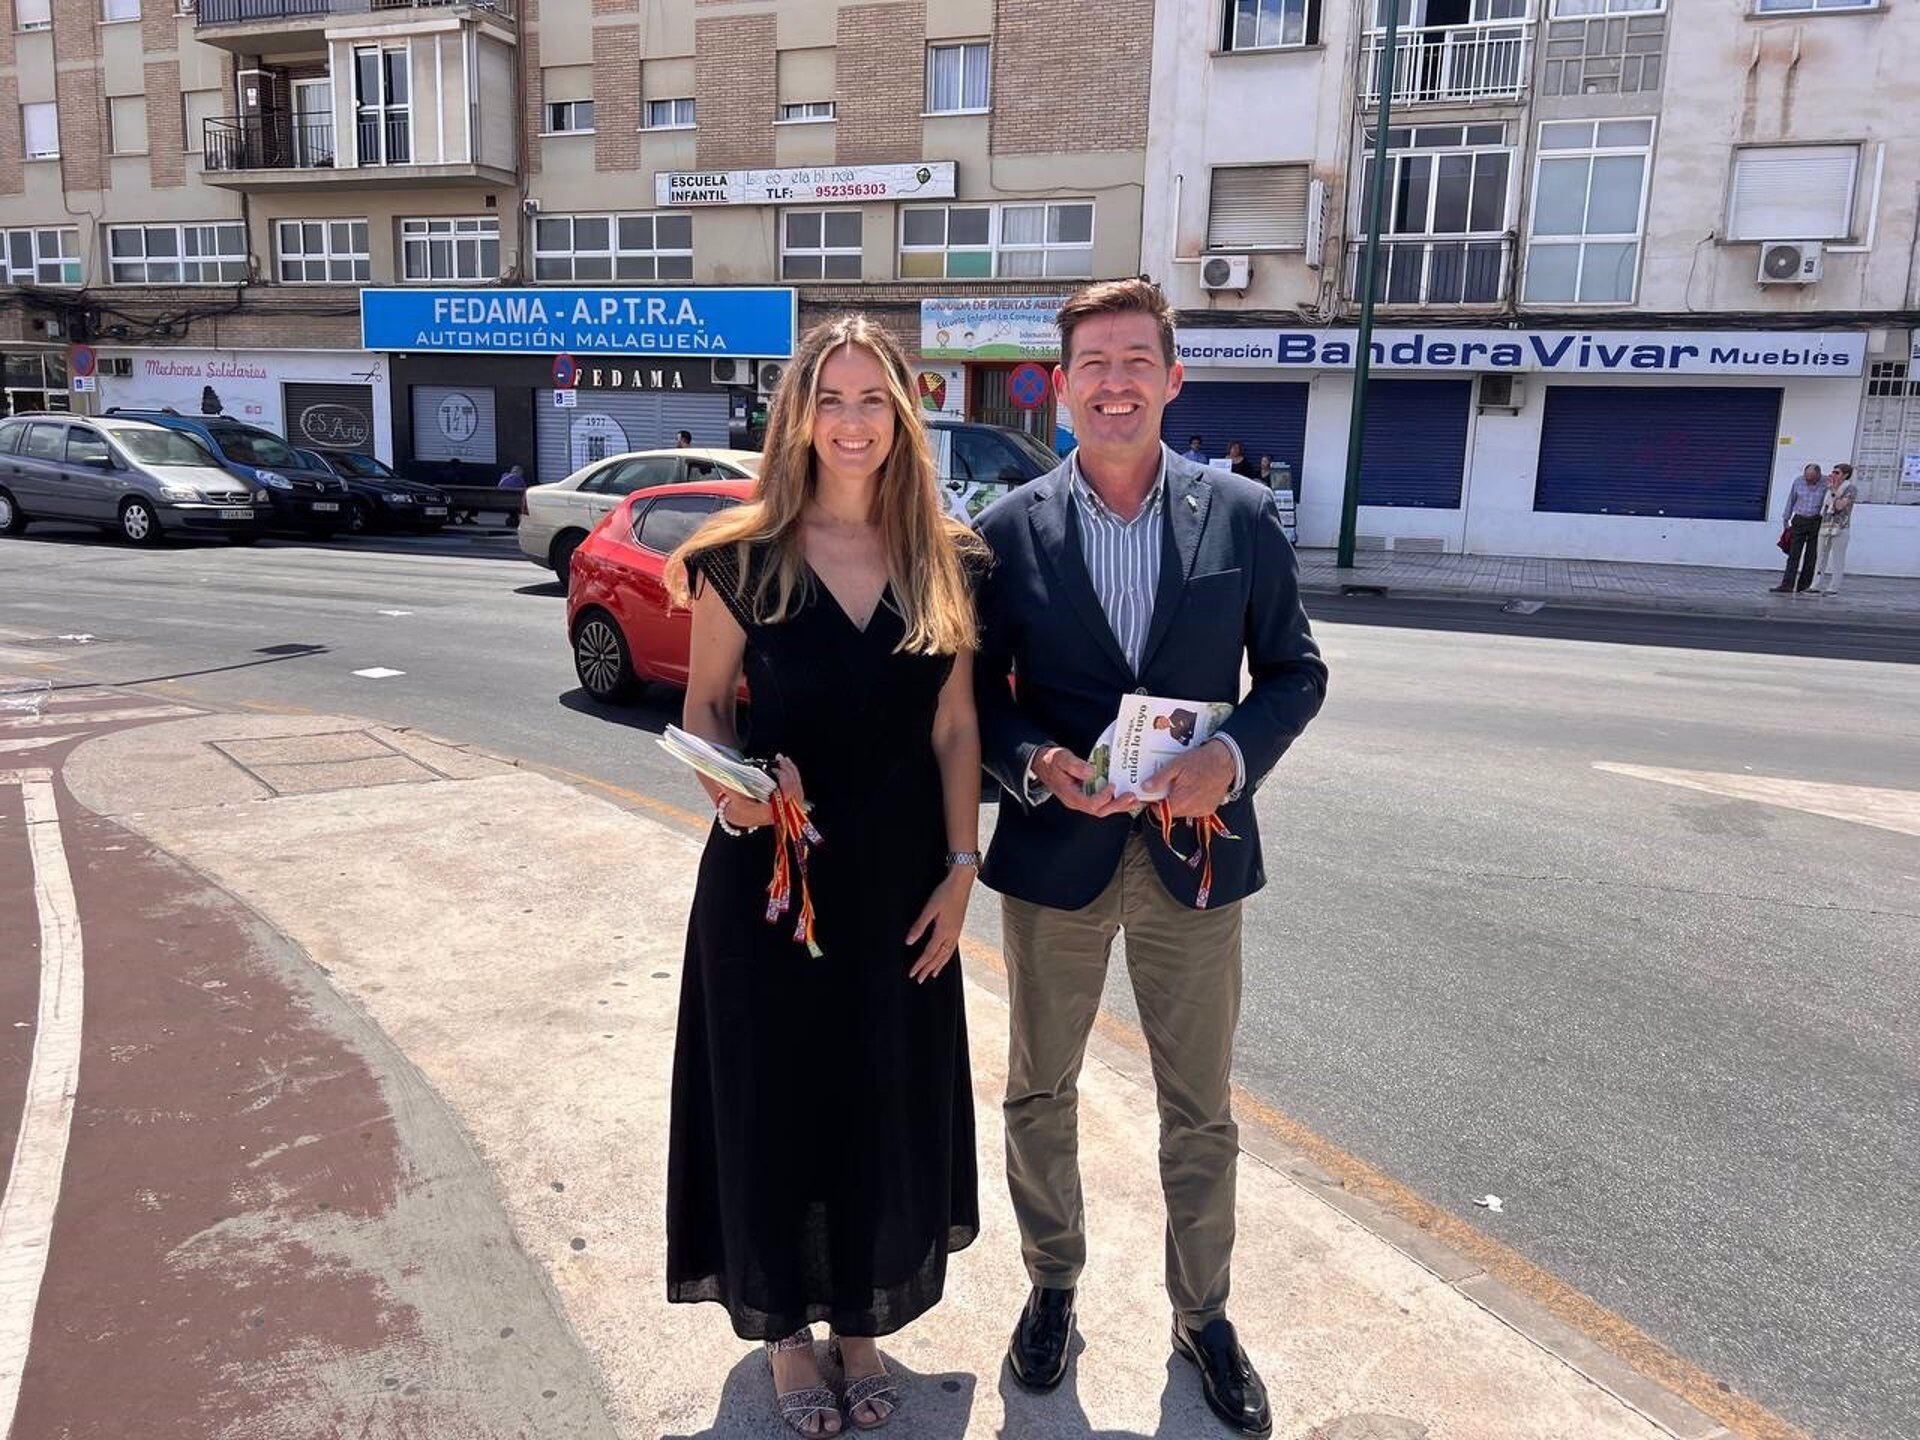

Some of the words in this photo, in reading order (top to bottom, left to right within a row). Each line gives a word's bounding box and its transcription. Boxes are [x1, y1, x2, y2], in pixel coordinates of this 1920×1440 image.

[671, 176, 727, 187] ESCUELA
[766, 188, 793, 199] TLF:
[815, 183, 886, 198] 952356303
[671, 190, 727, 202] INFANTIL
[434, 297, 549, 324] FEDAMA
[571, 298, 705, 326] A.P.T.R.A.
[416, 328, 565, 347] AUTOMOCIÓN
[577, 331, 726, 349] MALAGUEÑA
[1278, 334, 1522, 366] Bandera
[1529, 335, 1699, 368] Vivar
[1710, 347, 1850, 366] Muebles
[574, 369, 683, 388] FEDAMA
[1128, 750, 1139, 784] cuida
[1134, 704, 1147, 732] tuyo
